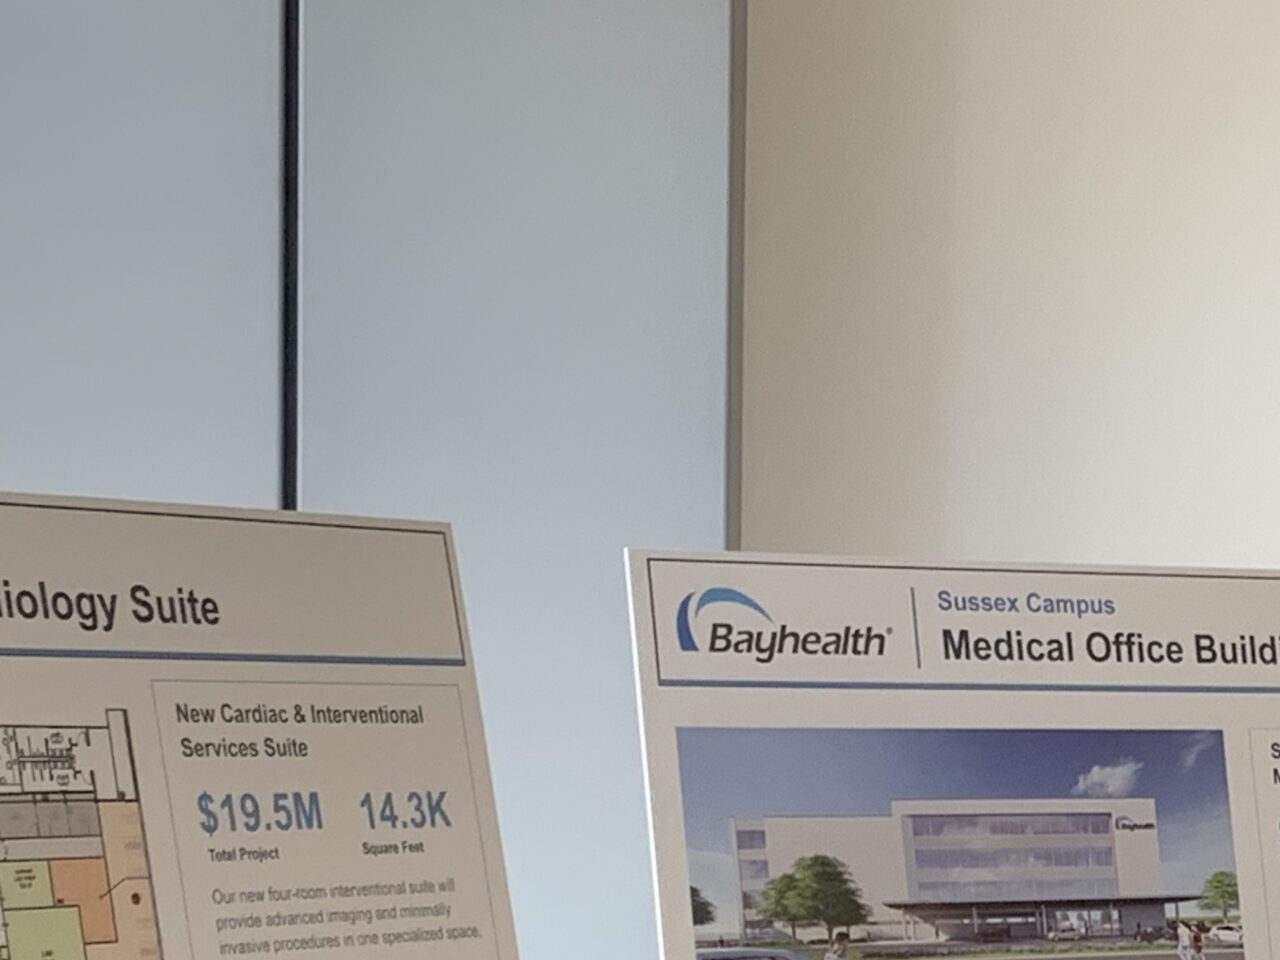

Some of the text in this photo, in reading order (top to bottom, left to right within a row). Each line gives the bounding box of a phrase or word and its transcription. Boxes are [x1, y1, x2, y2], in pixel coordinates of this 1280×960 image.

[0, 580, 219, 631] iology Suite
[938, 591, 1115, 618] Sussex Campus
[709, 623, 886, 663] Bayhealth
[943, 628, 1074, 662] Medical
[1086, 632, 1183, 664] Office
[176, 704, 423, 724] New Cardiac & Interventional
[181, 738, 307, 757] Services Suite
[198, 792, 323, 837] $19.5M
[361, 791, 452, 829] 14.3K
[208, 848, 279, 862] Total Project
[362, 842, 424, 855] Square Feet
[212, 878, 454, 904] Our new four-room interventional suite will
[216, 903, 450, 931] provide advanced imaging and minimally
[220, 940, 269, 955] invasive
[274, 934, 340, 954] procedures
[344, 934, 353, 946] in
[359, 933, 378, 945] one
[383, 927, 443, 946] specialized
